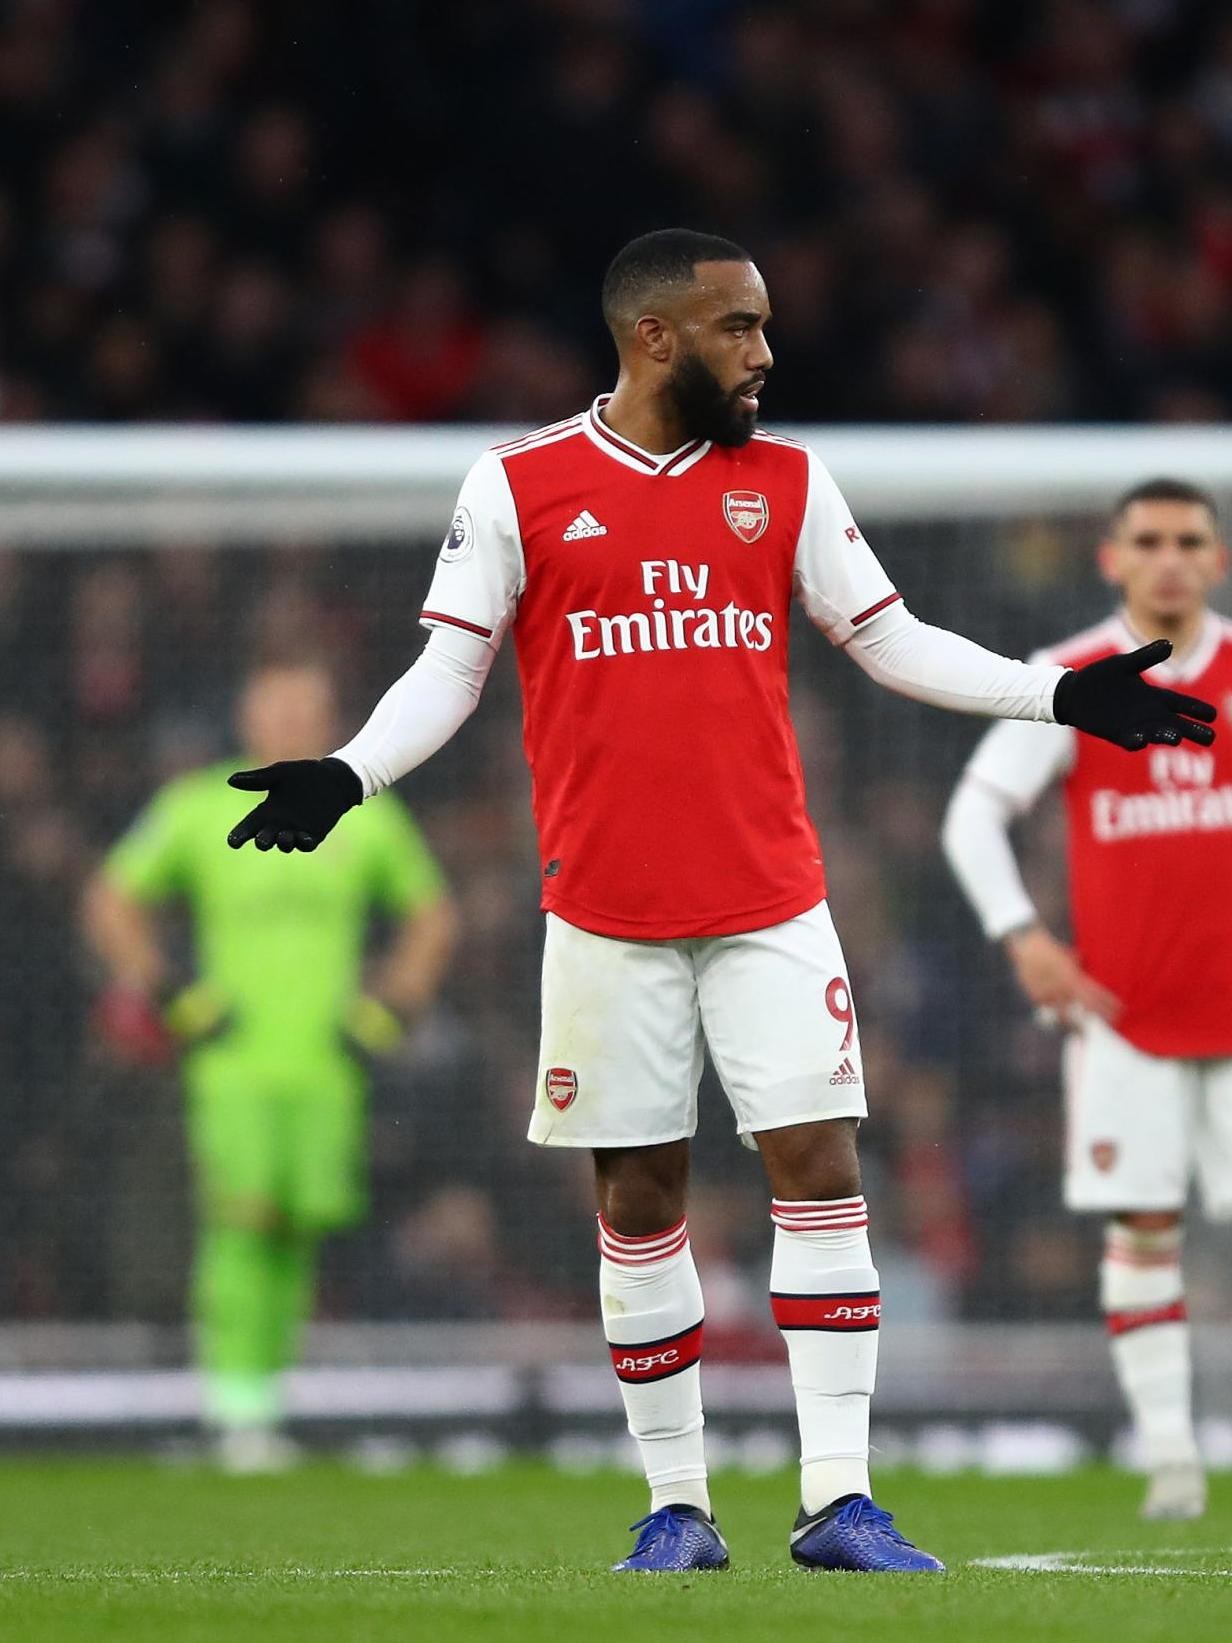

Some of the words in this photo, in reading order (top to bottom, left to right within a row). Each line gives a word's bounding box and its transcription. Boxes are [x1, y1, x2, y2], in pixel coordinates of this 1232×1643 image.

[562, 523, 608, 542] adidas
[640, 559, 709, 599] Fly
[565, 599, 773, 661] Emirates
[825, 976, 854, 1052] 9
[829, 1075, 860, 1086] adidas
